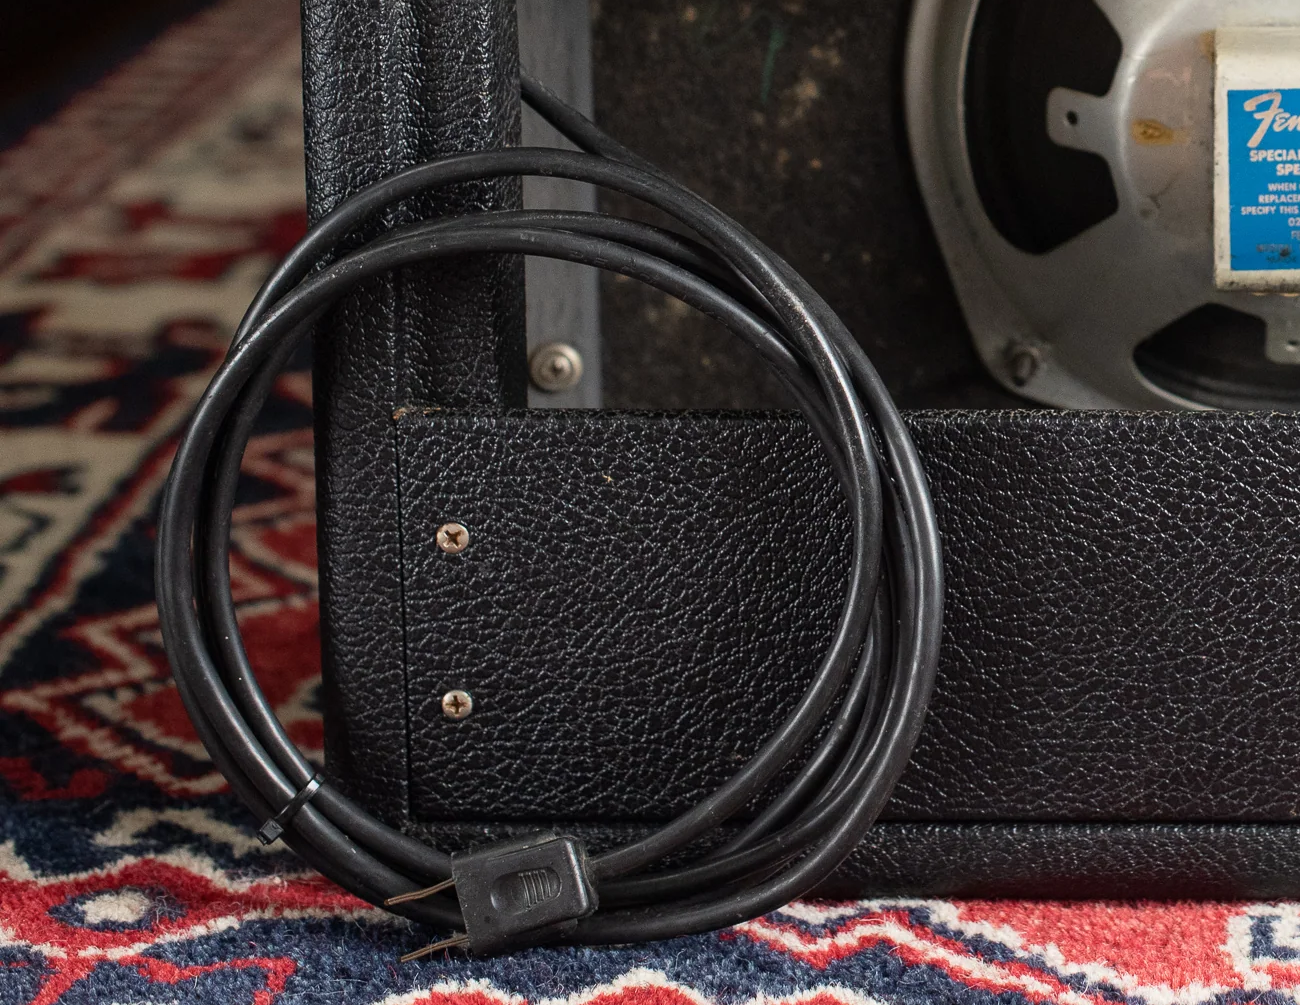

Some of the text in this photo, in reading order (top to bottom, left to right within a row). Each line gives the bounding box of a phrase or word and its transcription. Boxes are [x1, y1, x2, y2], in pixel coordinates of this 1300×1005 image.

[1268, 182, 1296, 191] WHEN
[1241, 206, 1276, 215] SPECIFY
[1280, 205, 1299, 214] THIS
